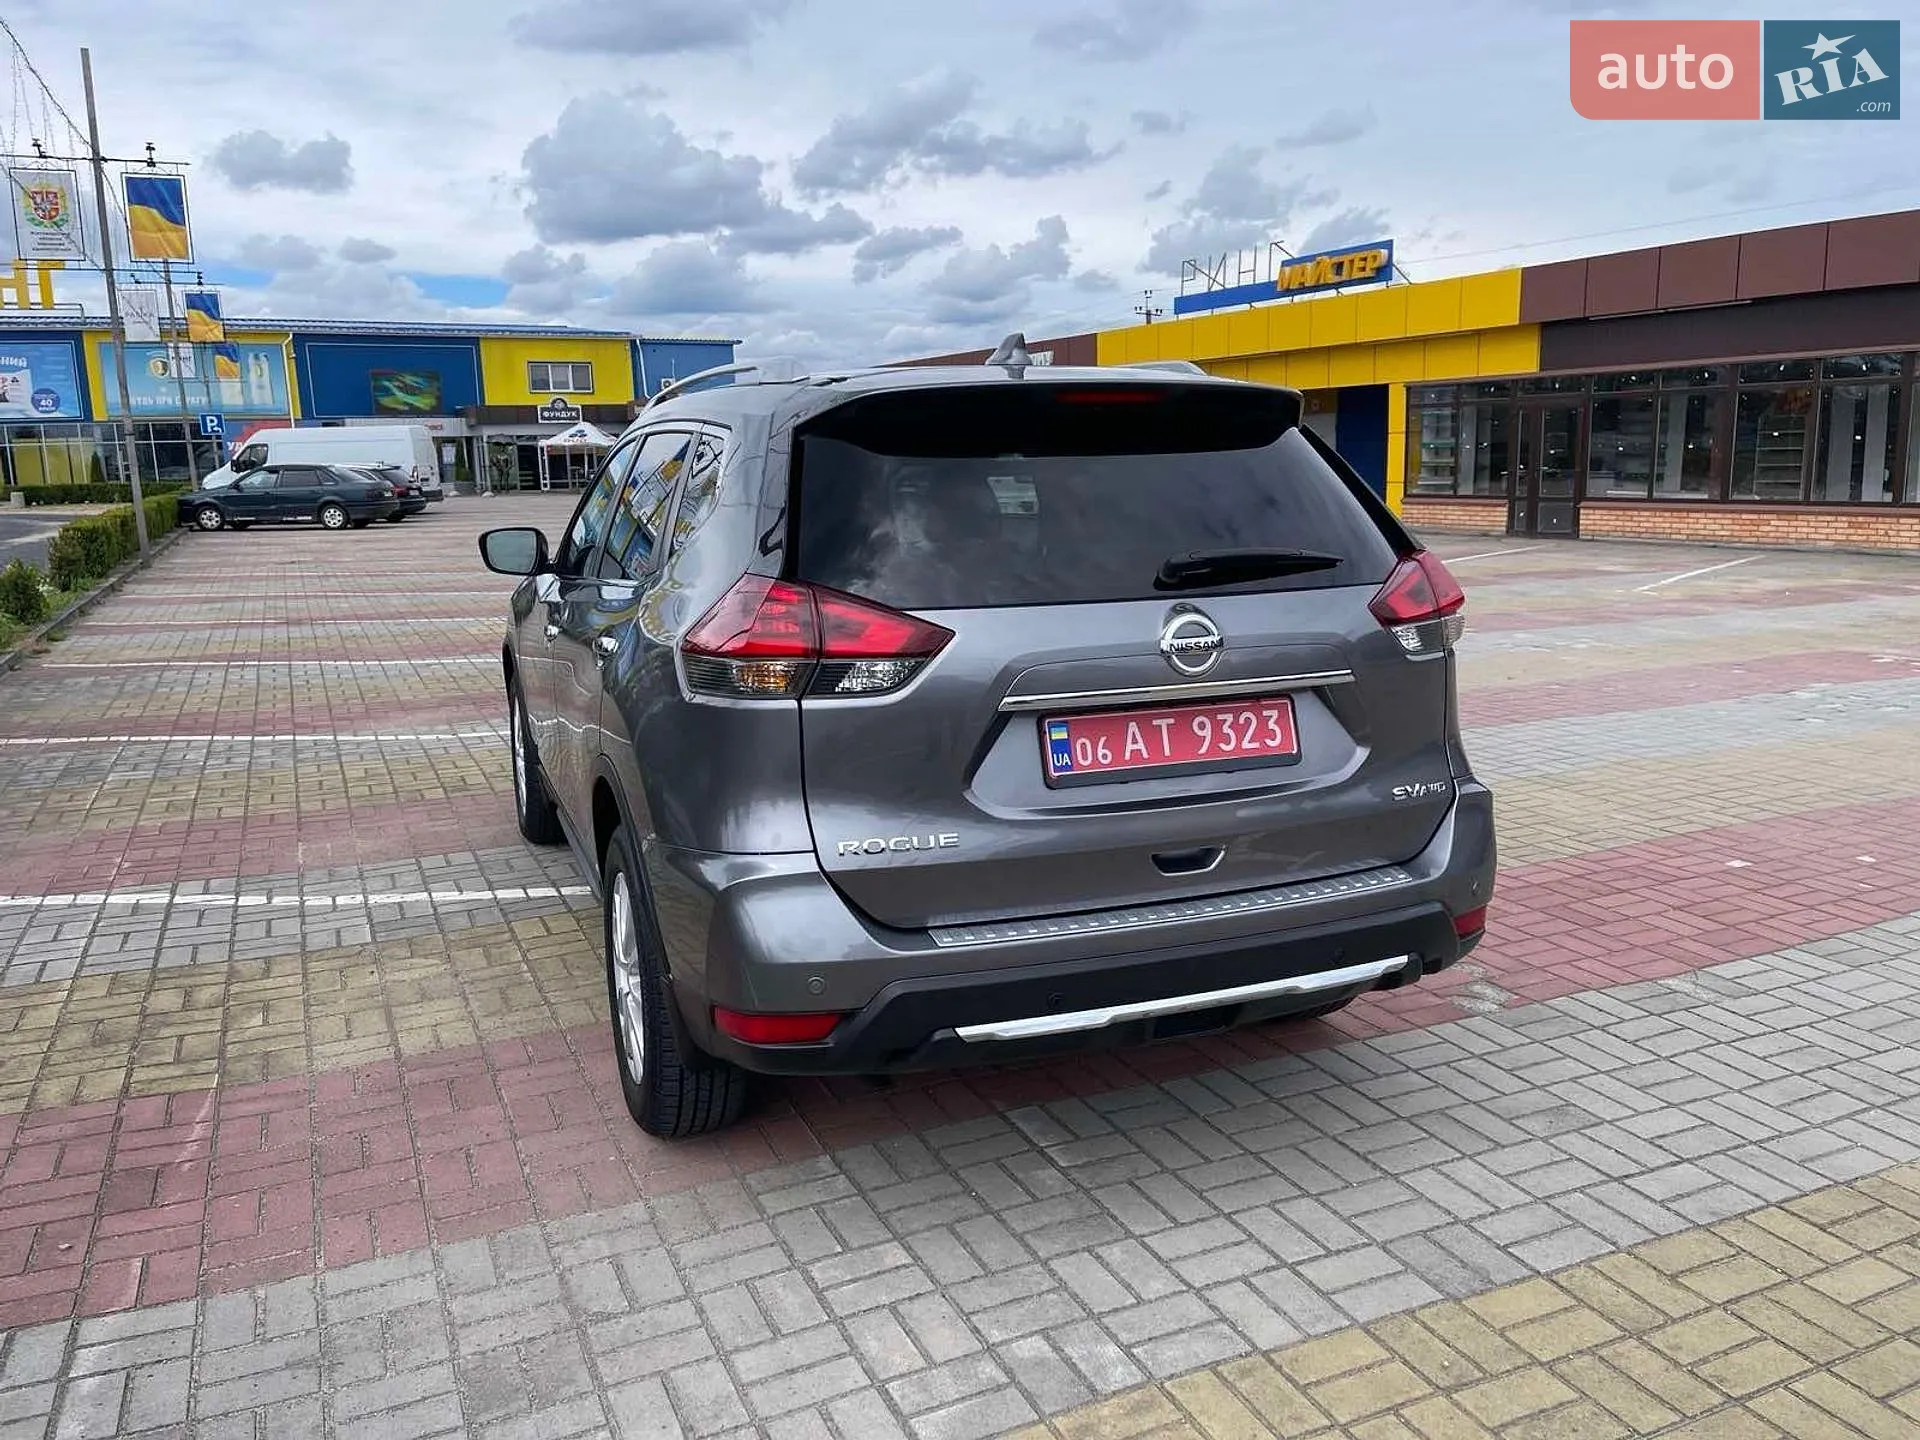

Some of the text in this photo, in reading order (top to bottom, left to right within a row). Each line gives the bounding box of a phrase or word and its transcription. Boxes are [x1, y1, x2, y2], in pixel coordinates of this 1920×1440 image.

[1276, 248, 1388, 291] МАЙСТЕР
[543, 410, 577, 418] ФУНДУК
[1169, 637, 1224, 653] NISSAN
[1075, 709, 1283, 767] 06 AT 9323
[1053, 753, 1072, 767] UA
[836, 832, 960, 856] ROGUE
